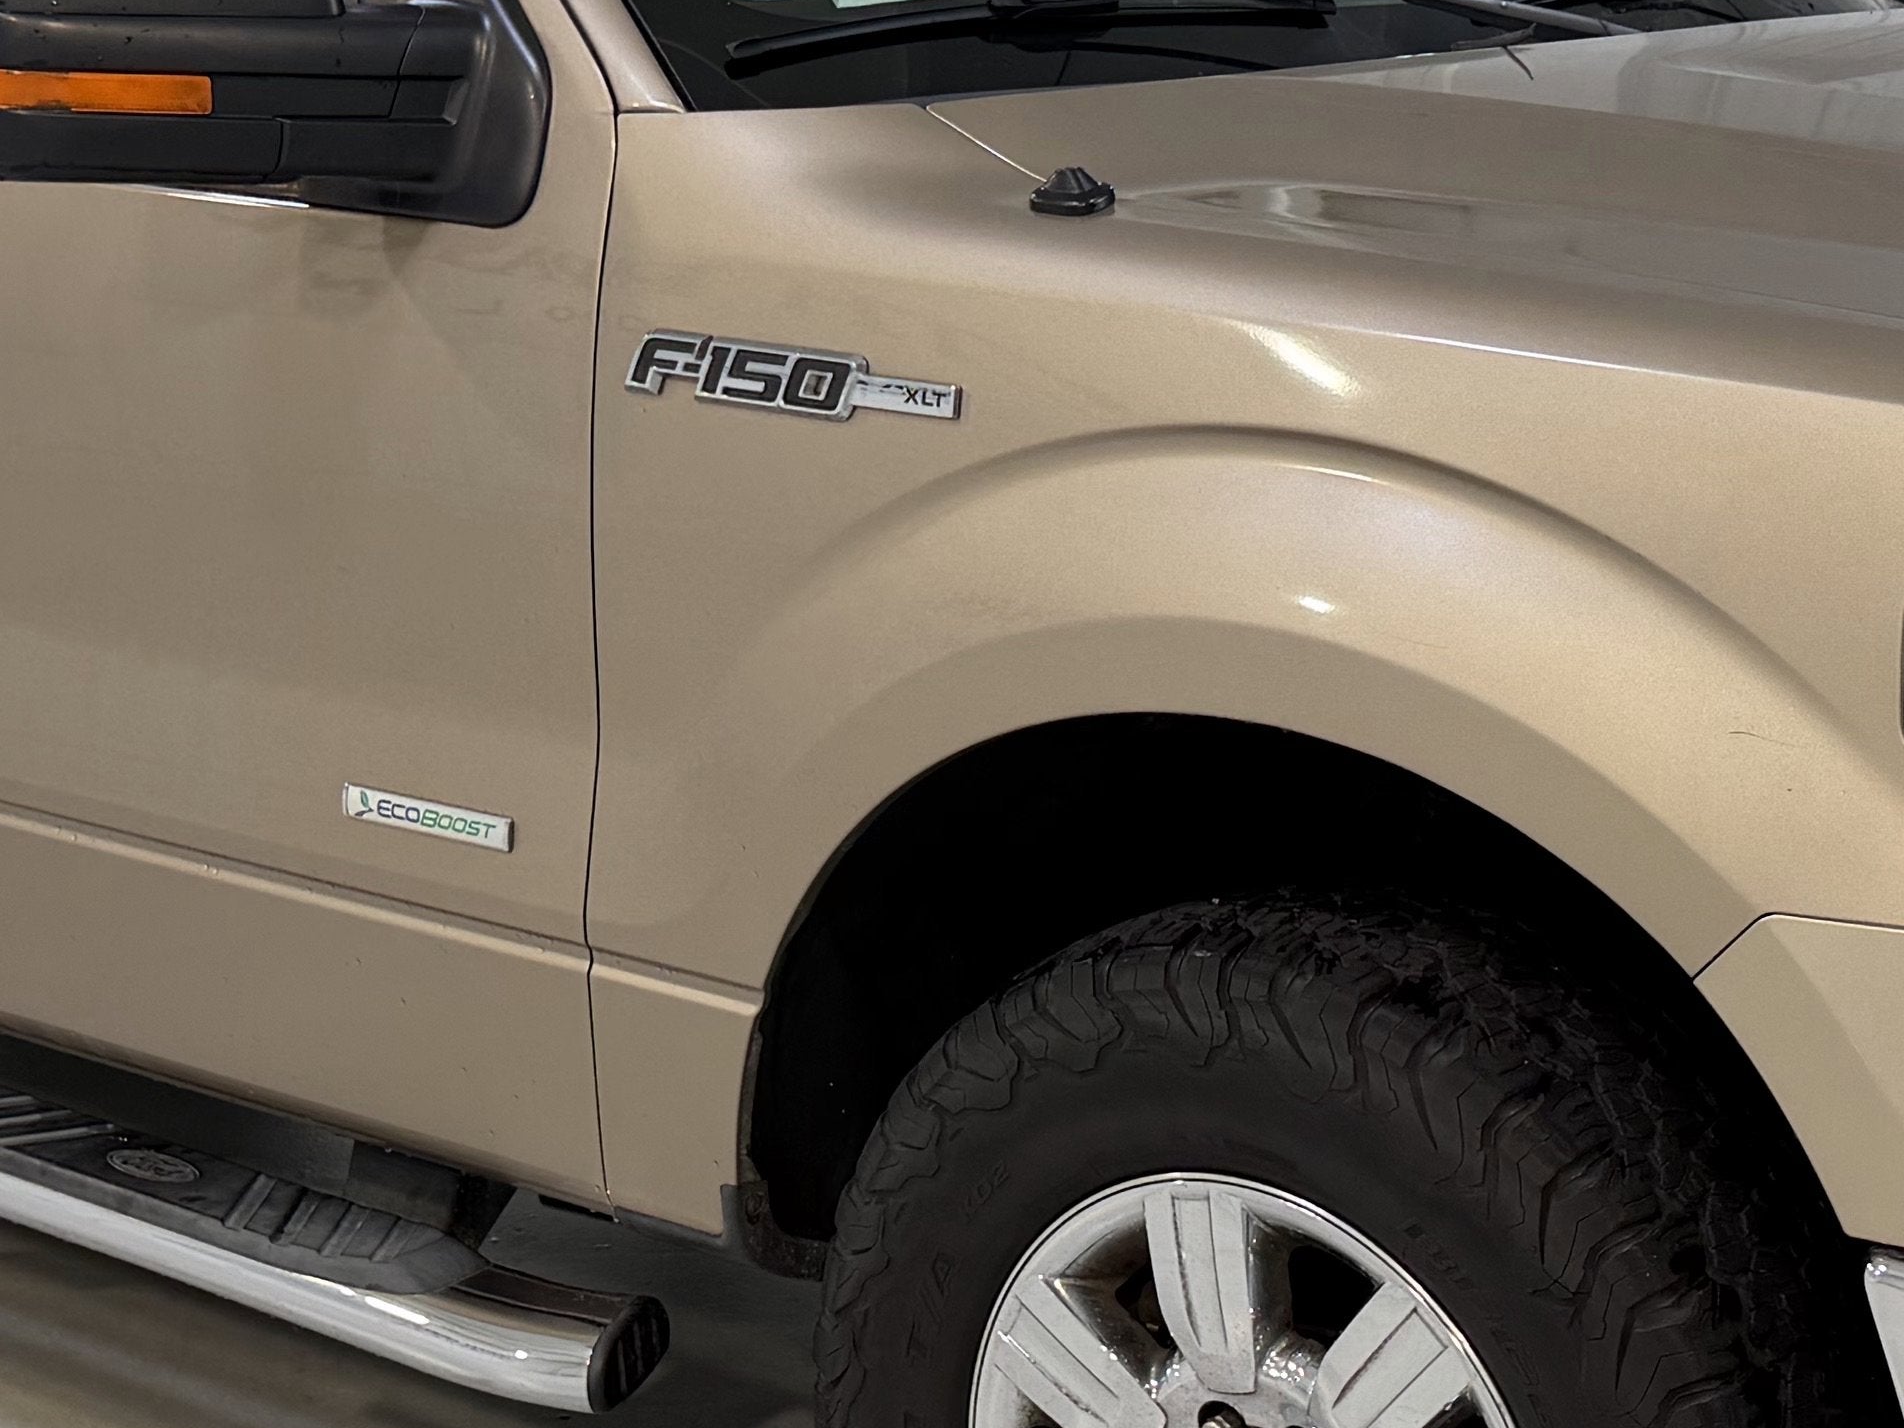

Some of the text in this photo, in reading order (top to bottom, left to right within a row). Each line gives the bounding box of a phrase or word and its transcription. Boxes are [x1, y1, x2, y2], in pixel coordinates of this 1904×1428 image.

[627, 333, 951, 417] F-150 XLT
[377, 799, 497, 839] ECOBOOST
